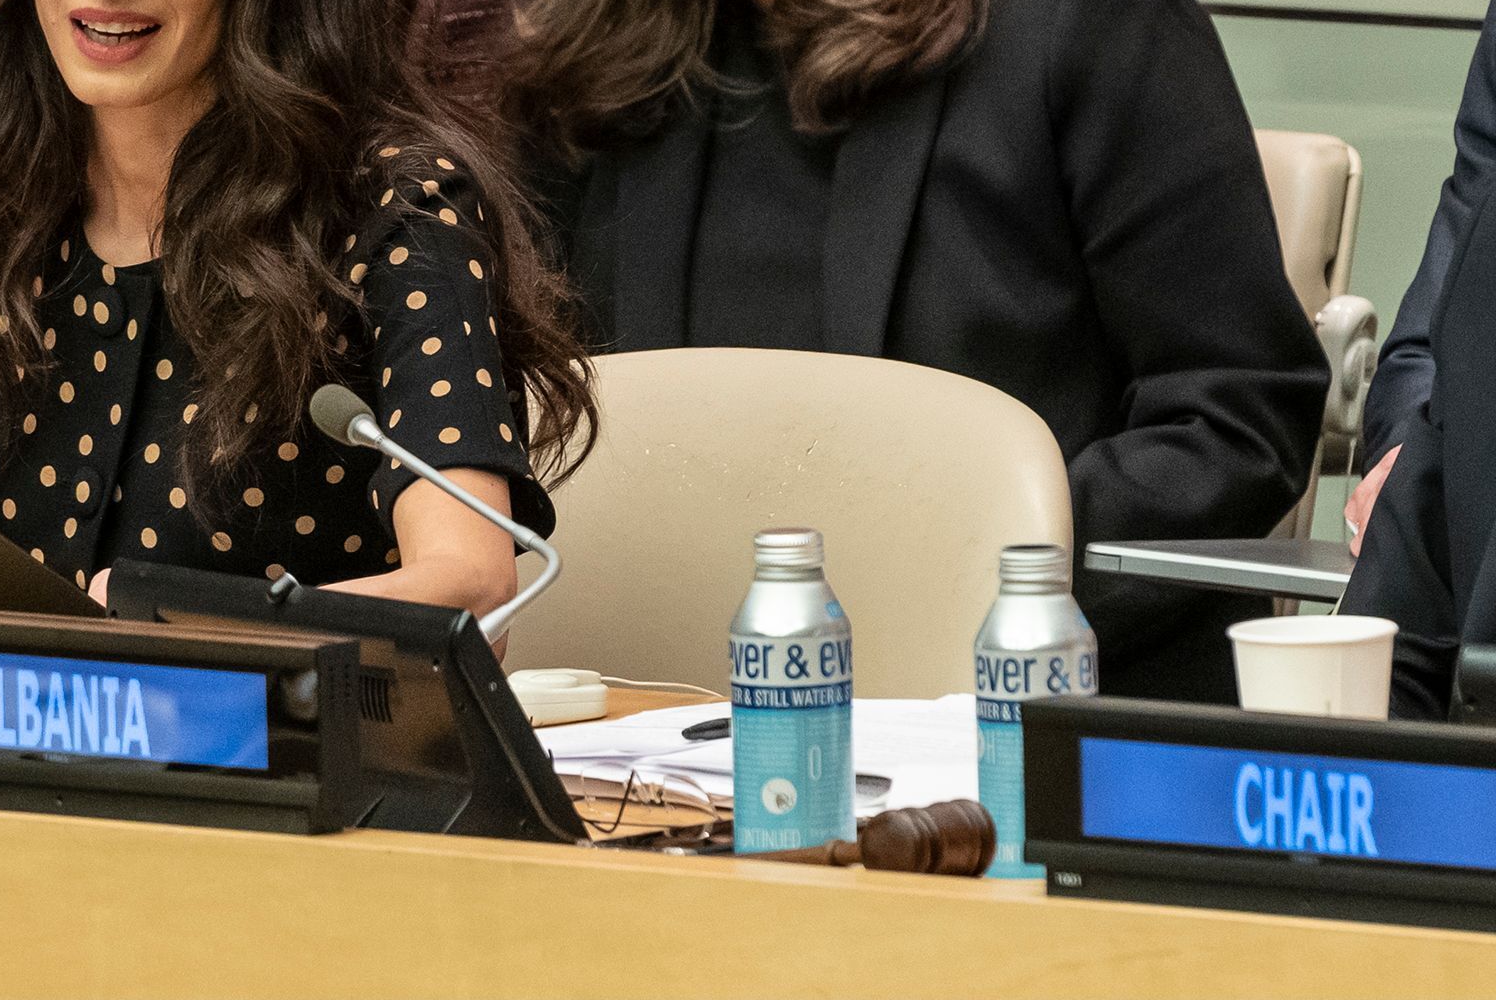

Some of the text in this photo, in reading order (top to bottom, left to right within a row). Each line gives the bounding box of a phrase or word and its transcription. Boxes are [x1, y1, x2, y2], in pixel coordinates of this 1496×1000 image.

[977, 654, 1037, 693] ever
[754, 690, 791, 707] STILL
[791, 688, 836, 706] WATER
[1235, 762, 1379, 857] CHAIR
